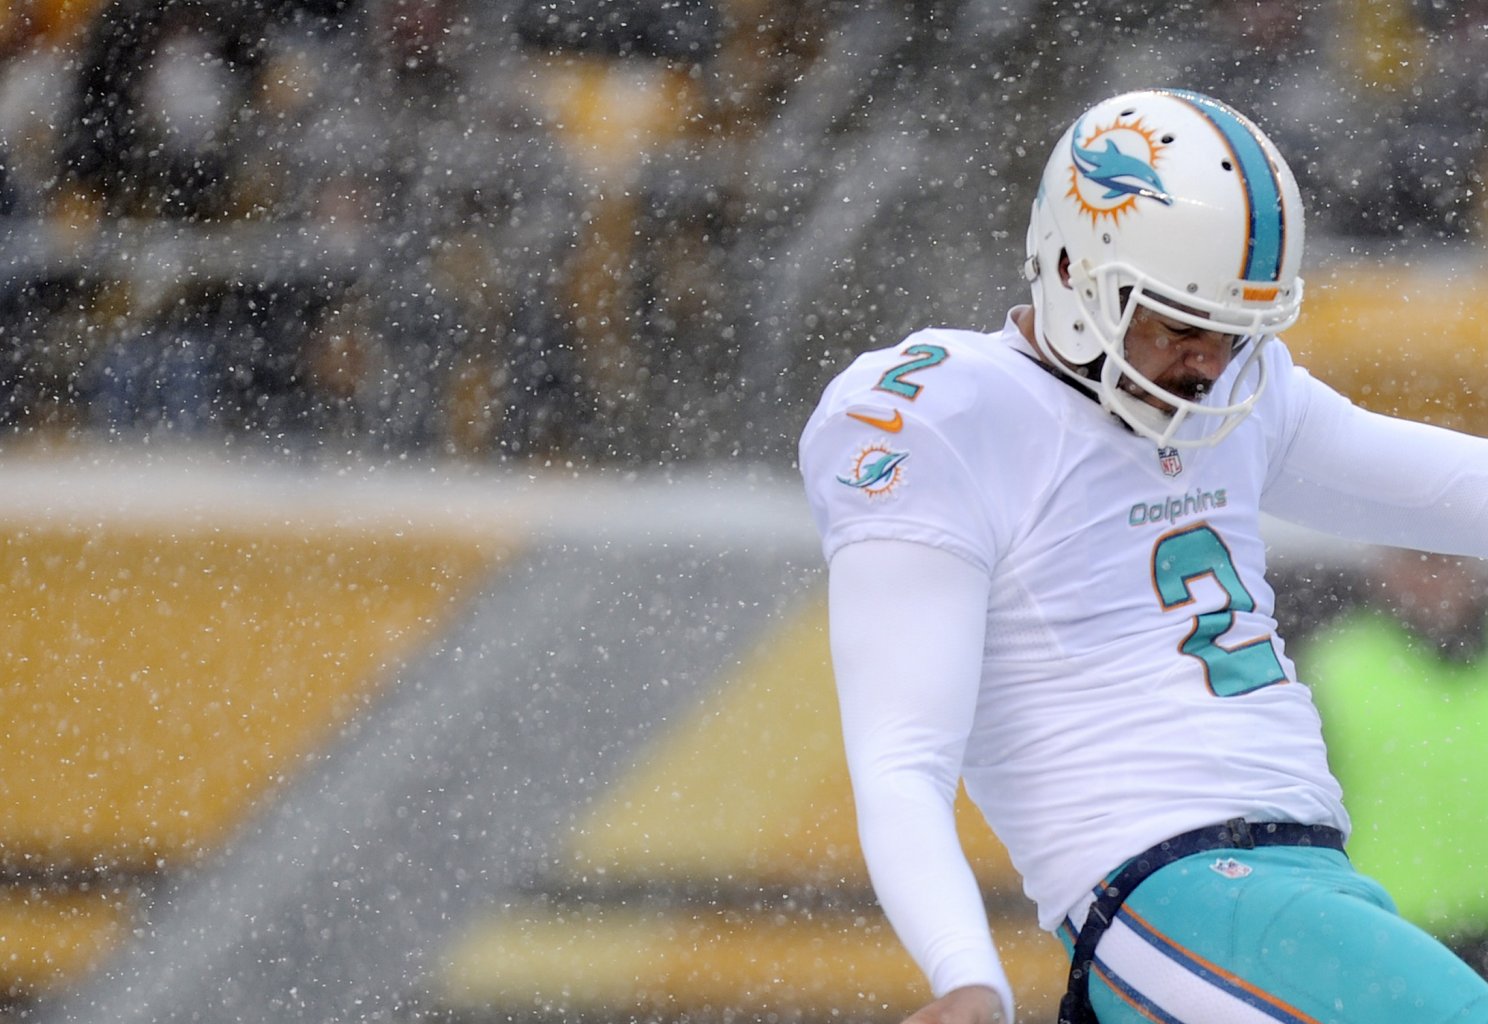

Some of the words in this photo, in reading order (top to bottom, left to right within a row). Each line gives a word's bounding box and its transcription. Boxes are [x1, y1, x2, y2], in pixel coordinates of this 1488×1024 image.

[871, 344, 950, 401] 2
[1128, 487, 1228, 526] Dolphins
[1150, 520, 1290, 697] 2
